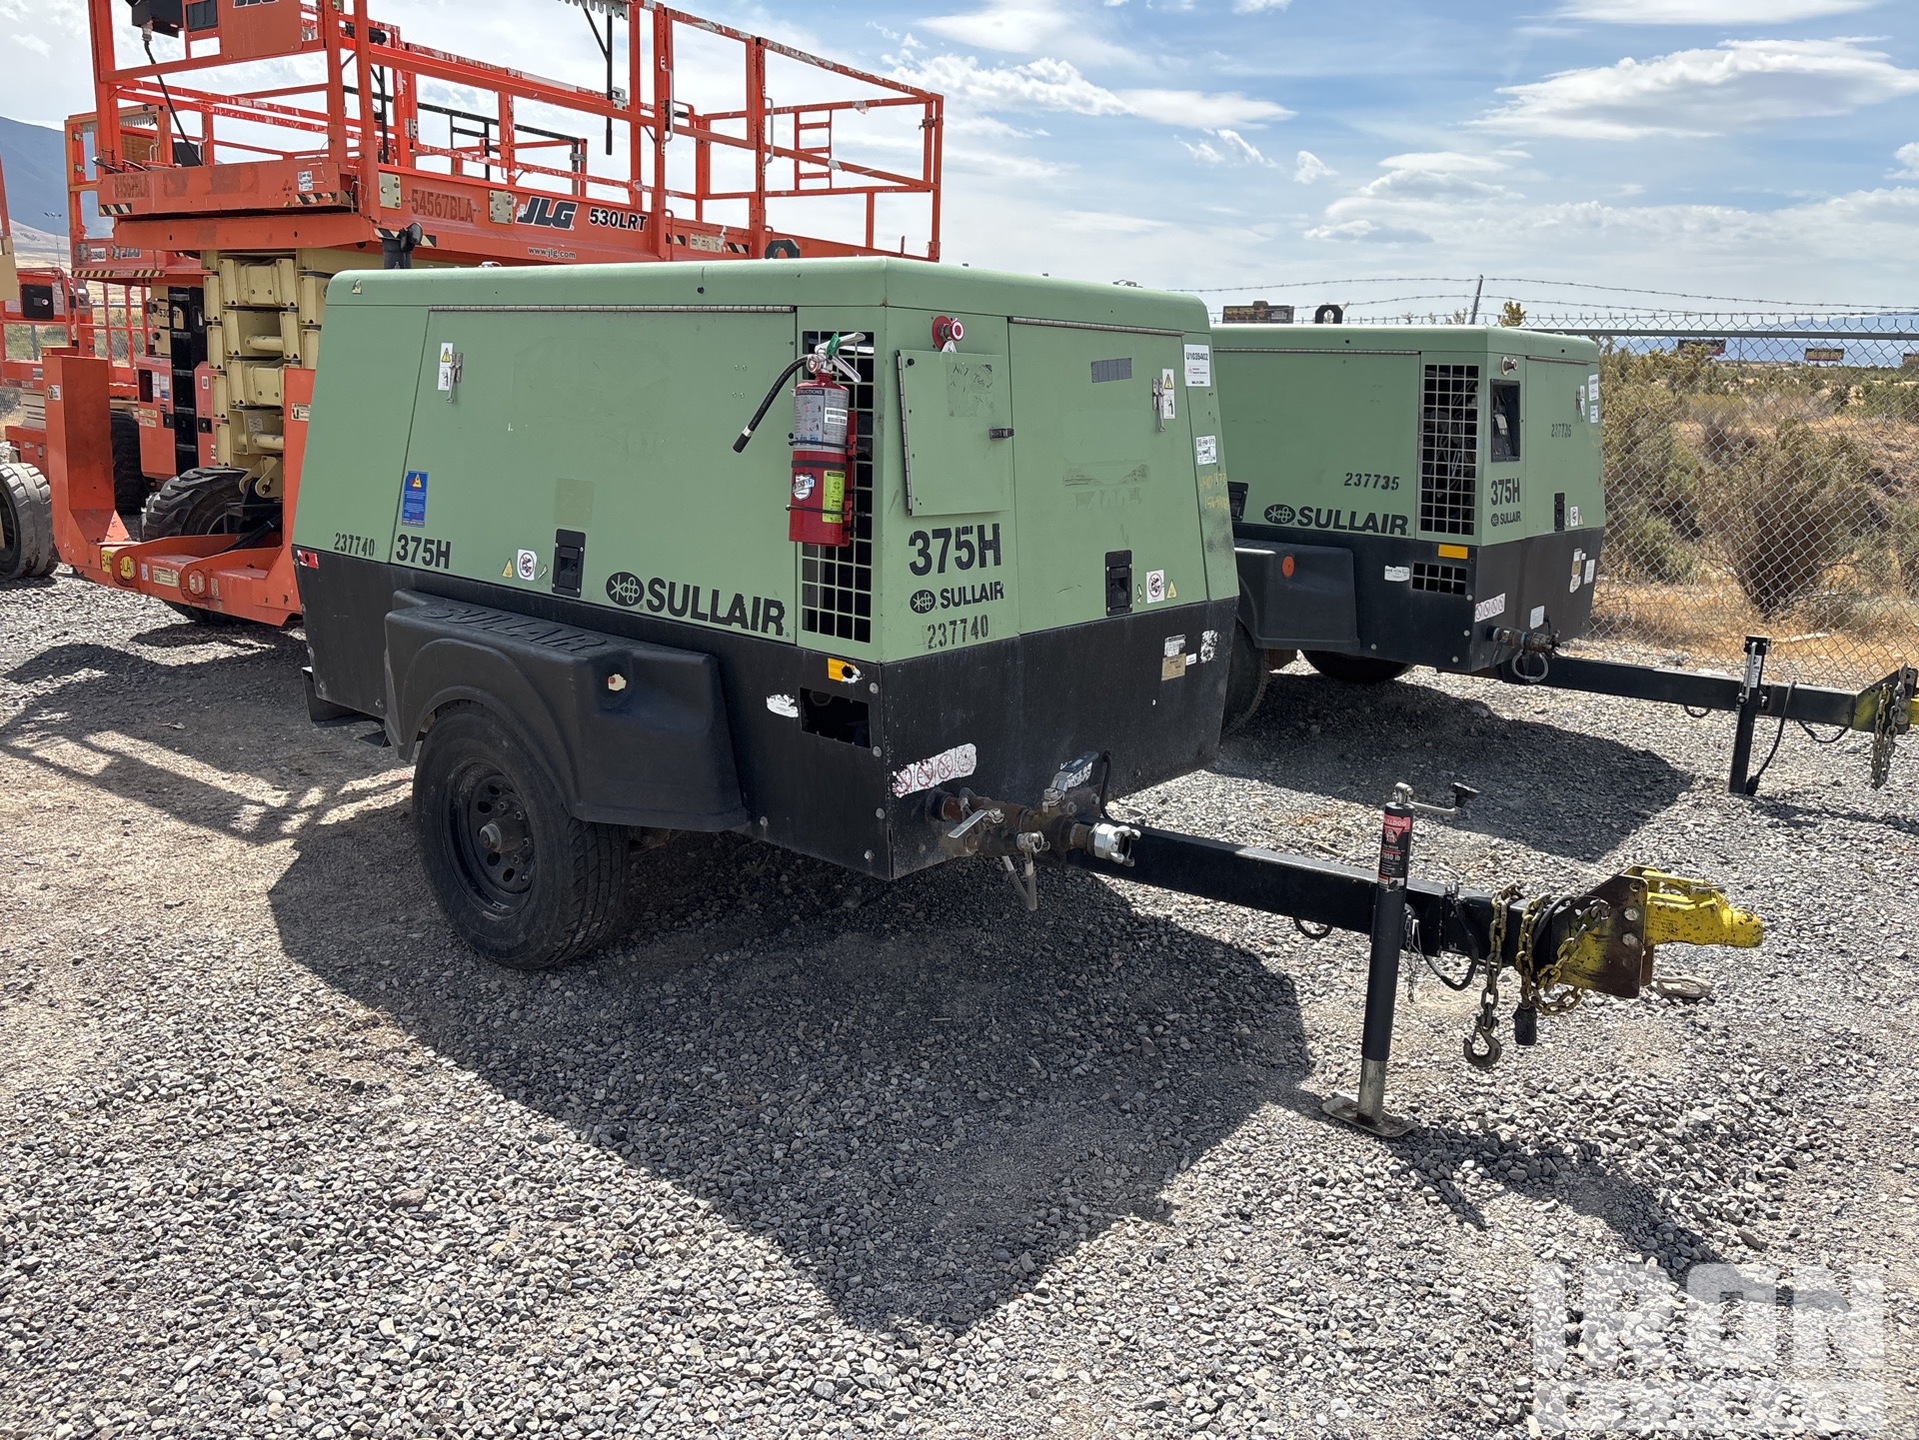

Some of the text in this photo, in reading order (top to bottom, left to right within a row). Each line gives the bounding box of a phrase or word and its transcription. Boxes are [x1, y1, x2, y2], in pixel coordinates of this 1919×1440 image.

[411, 189, 474, 223] 54567BLA
[517, 197, 647, 231] JLG 530LRT
[528, 247, 576, 259] www.jlg.com
[1344, 472, 1400, 490] 237735
[1490, 478, 1520, 506] 375H
[1296, 506, 1409, 536] SULLAIR
[1500, 511, 1521, 525] SULLAIR
[334, 532, 375, 557] 237740
[396, 534, 451, 569] 375H
[908, 523, 1002, 576] 375H
[646, 577, 785, 637] SULLAIR
[940, 581, 1004, 609] SULLAIR
[927, 614, 989, 649] 237740
